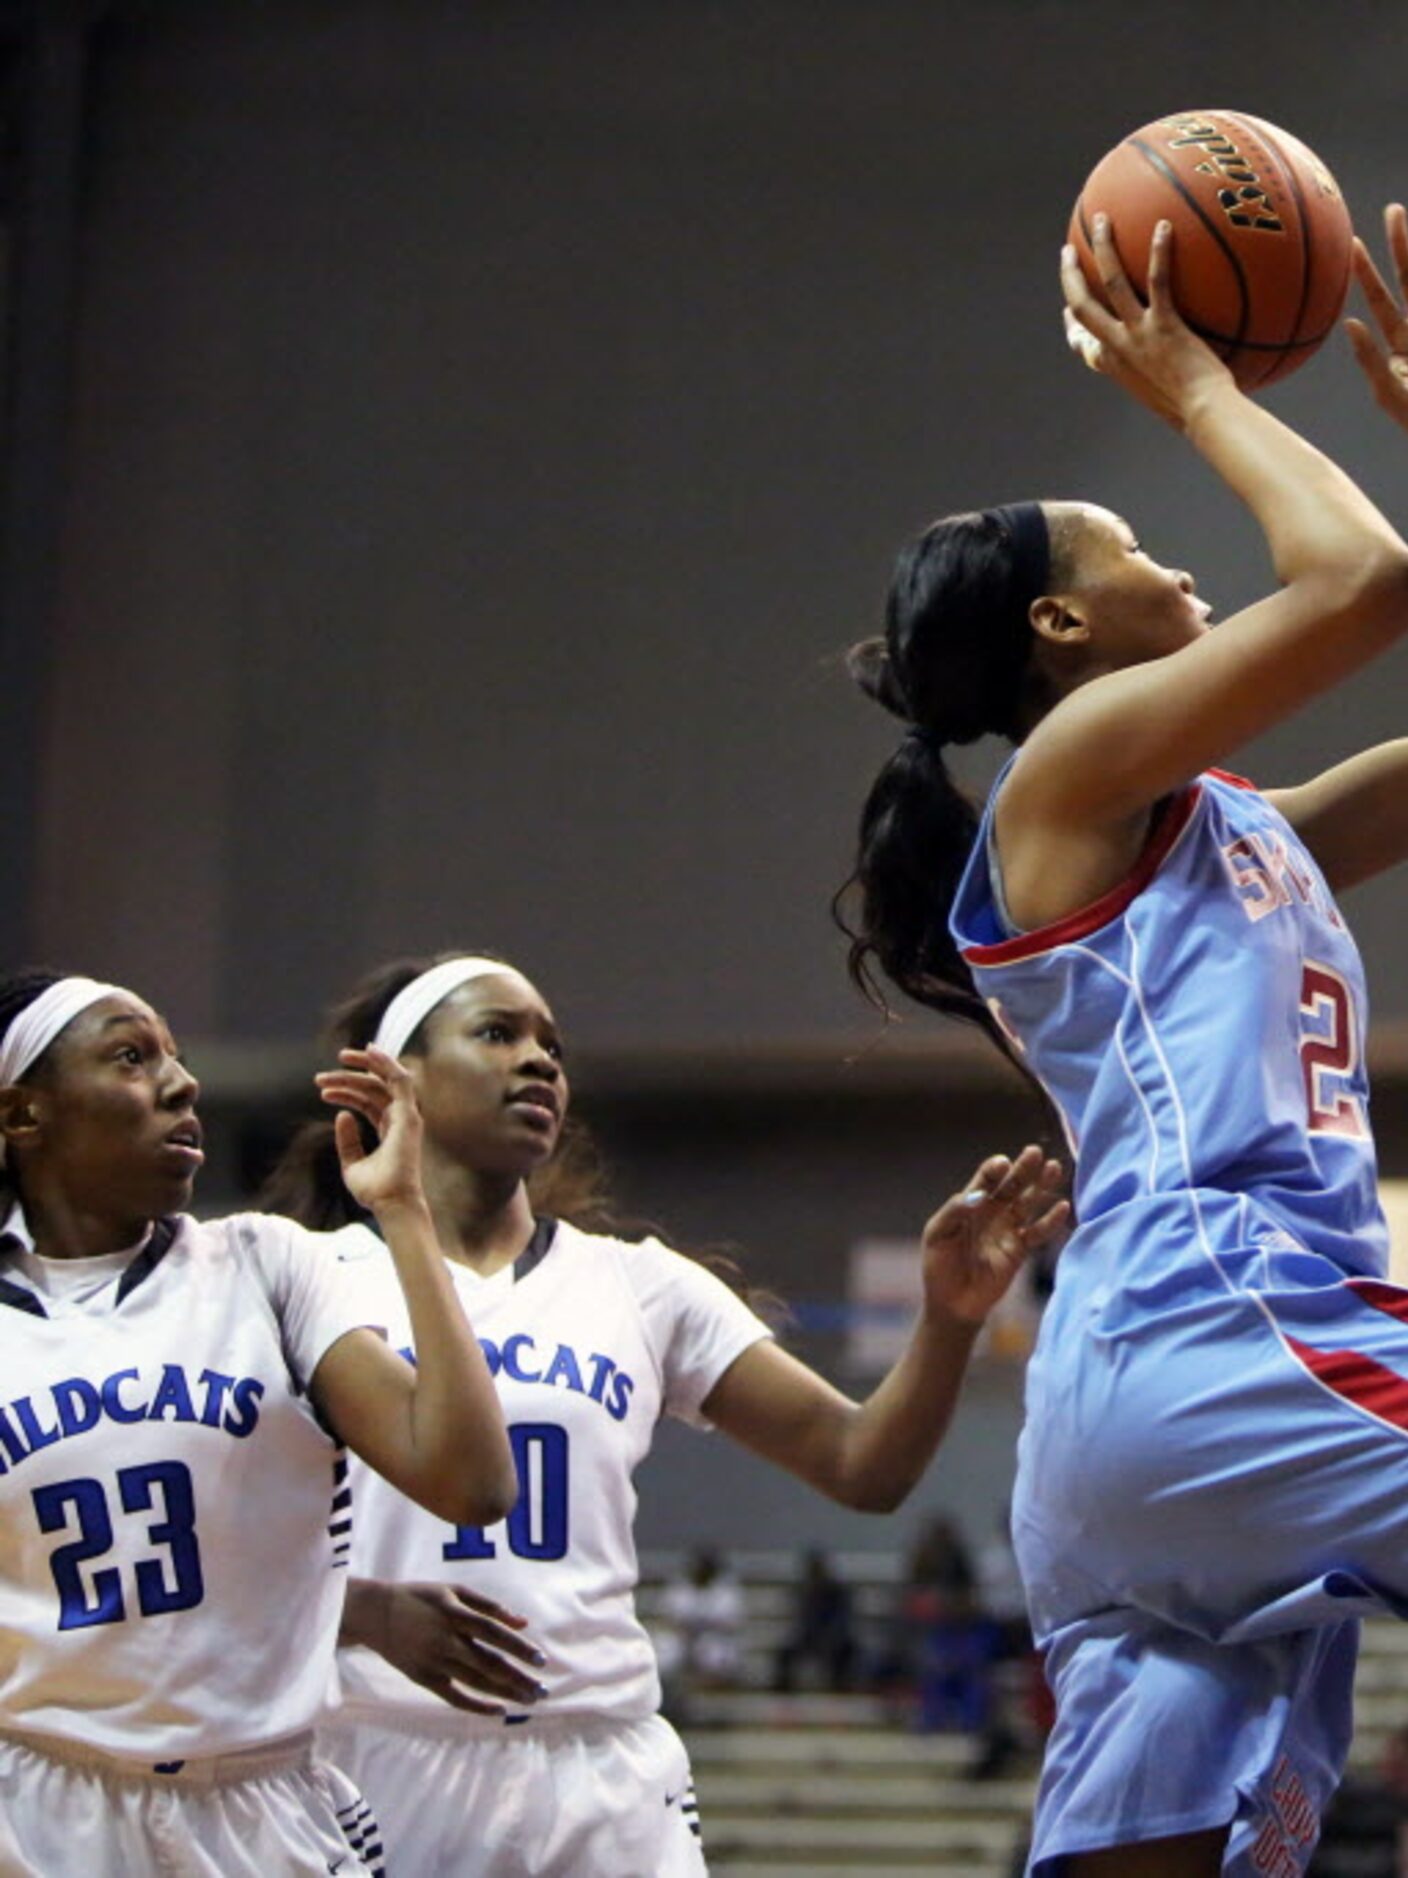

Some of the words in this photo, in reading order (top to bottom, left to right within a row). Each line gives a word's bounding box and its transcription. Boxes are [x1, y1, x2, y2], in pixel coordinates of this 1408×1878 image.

[1299, 958, 1371, 1142] 2
[0, 1363, 265, 1476] ILDCATS
[442, 1421, 569, 1562] 0
[30, 1459, 204, 1632] 23
